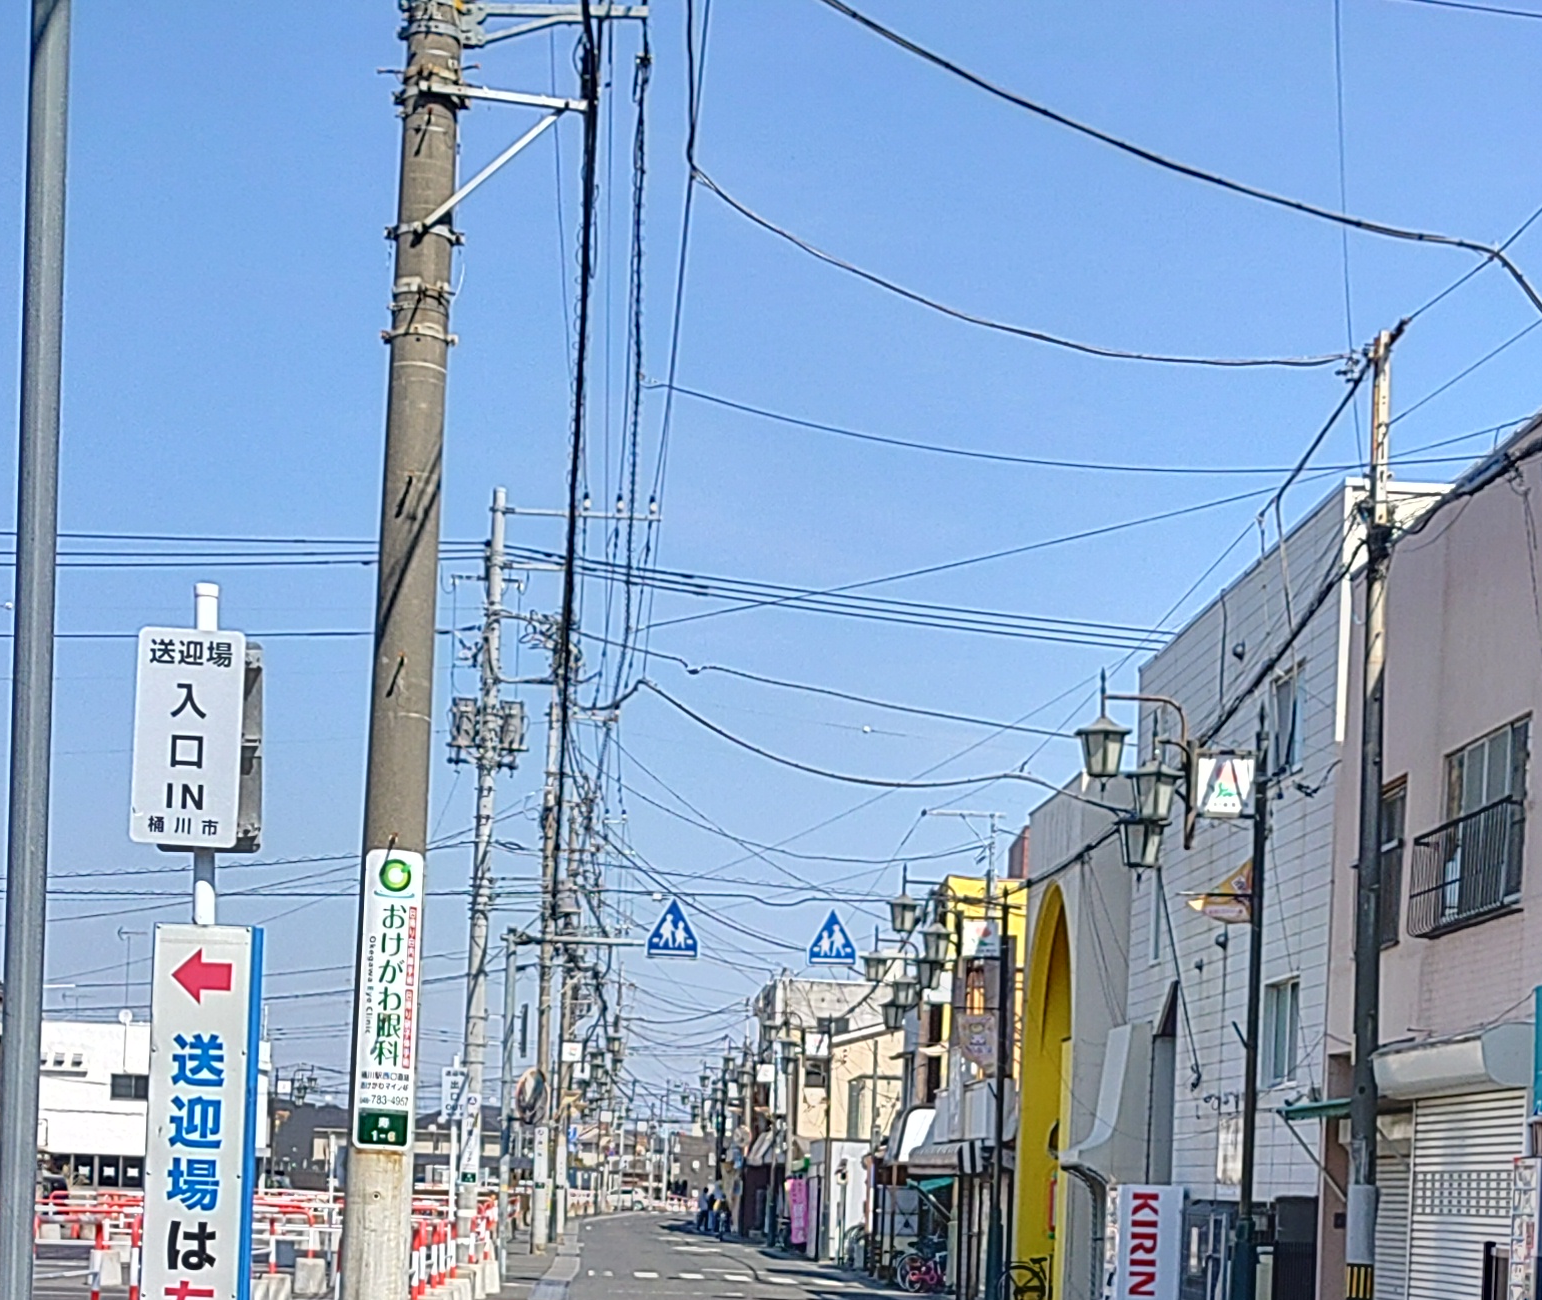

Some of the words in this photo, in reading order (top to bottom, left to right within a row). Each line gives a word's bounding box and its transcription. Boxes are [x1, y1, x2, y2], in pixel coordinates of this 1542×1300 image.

[149, 638, 233, 668] 送迎場
[170, 682, 207, 769] 入口
[165, 782, 205, 811] IN
[147, 815, 219, 836] 桶川市
[367, 935, 377, 983] Okegawa
[365, 985, 374, 1003] Eye
[374, 903, 408, 1067] おけがわ眼科
[364, 1006, 374, 1034] Clinic
[1128, 1192, 1160, 1297] KIRIN
